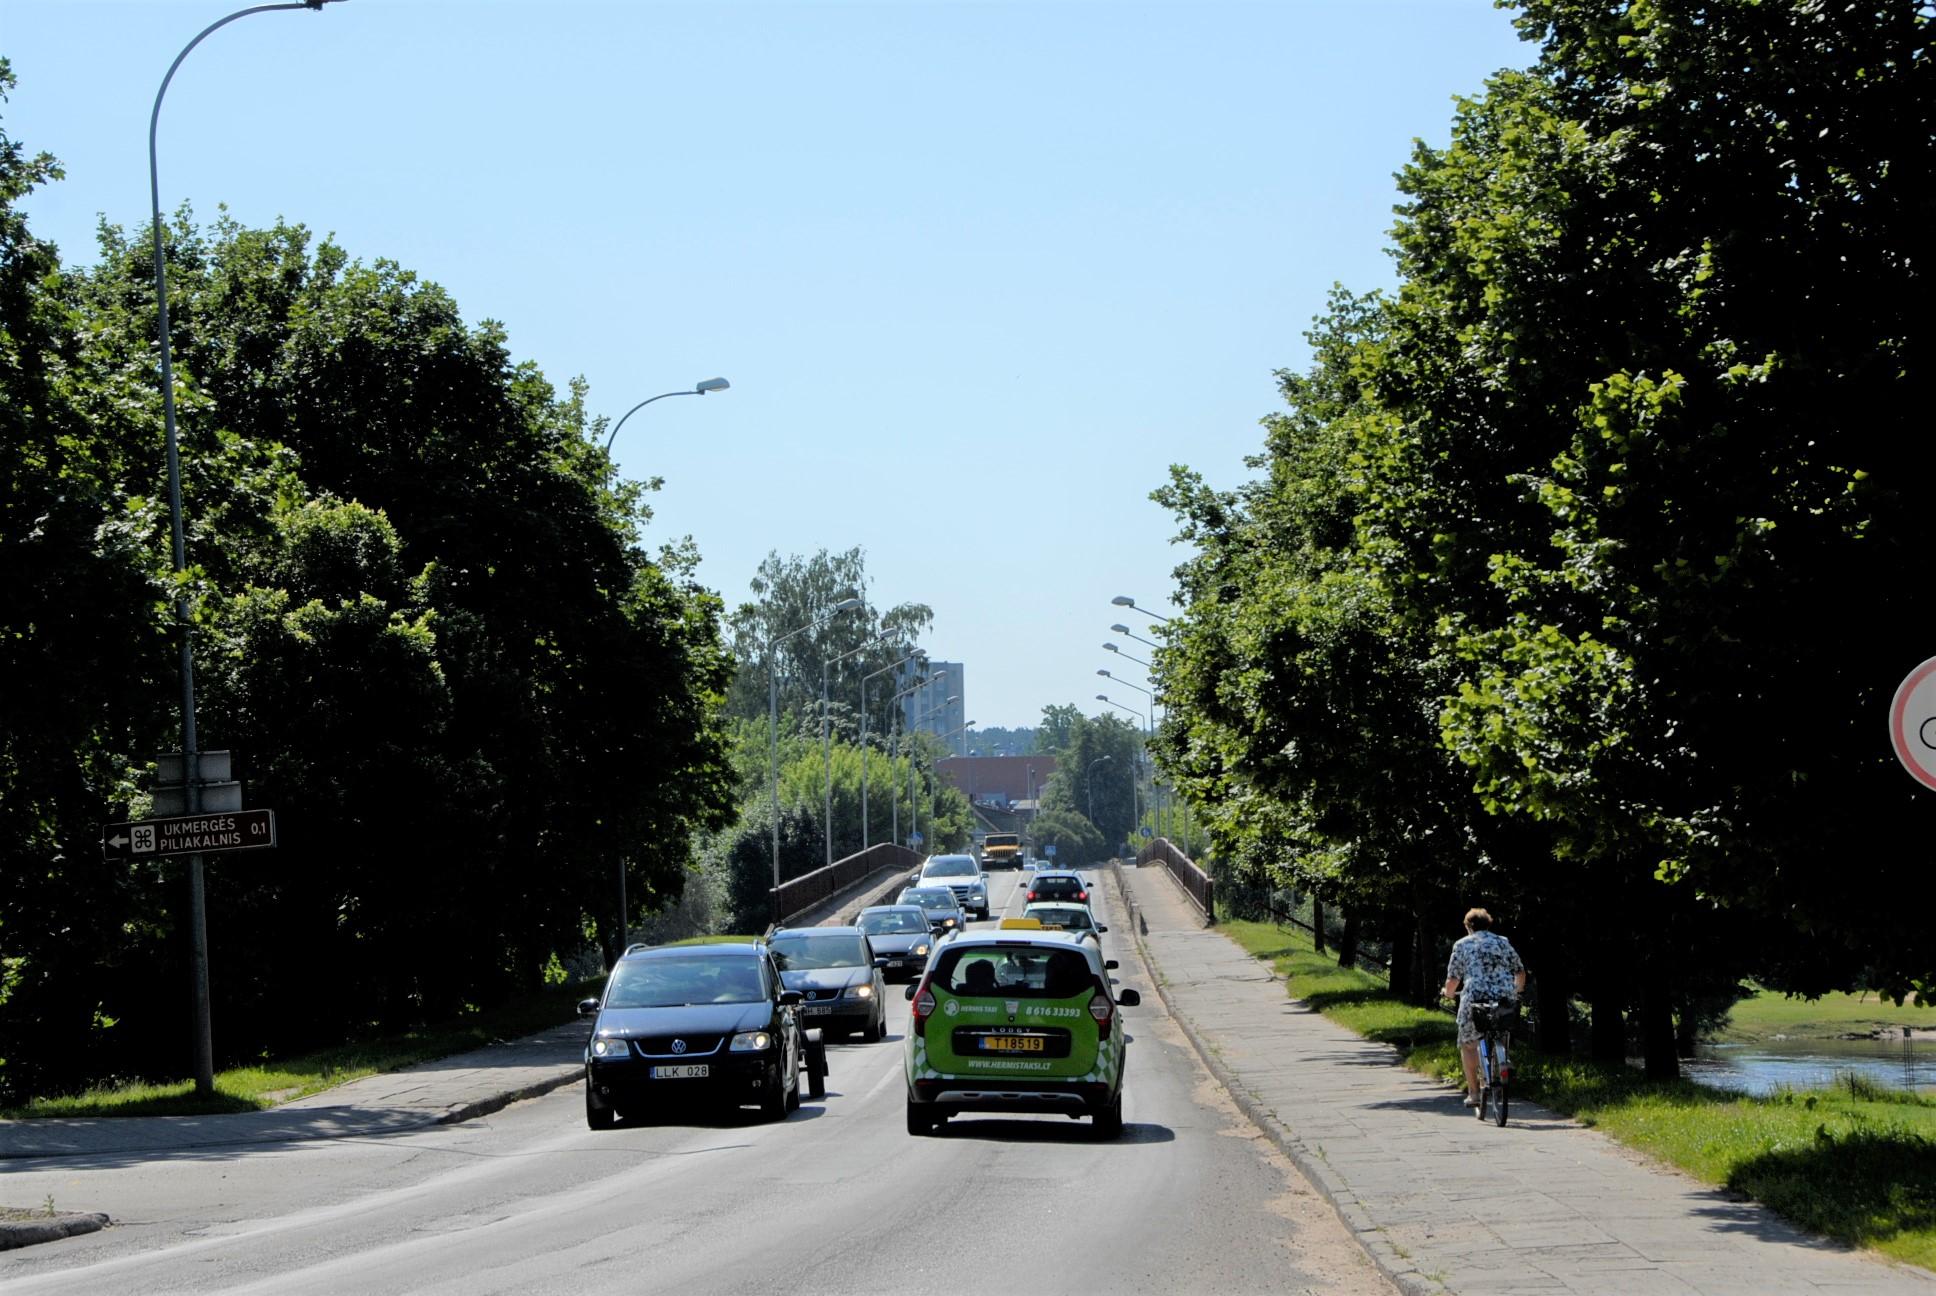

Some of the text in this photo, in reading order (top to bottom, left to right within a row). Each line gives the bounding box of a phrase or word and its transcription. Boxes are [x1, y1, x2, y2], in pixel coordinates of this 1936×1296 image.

[164, 816, 236, 836] UKMERGĖS
[160, 832, 241, 850] PILIAKALNIS
[995, 1038, 1040, 1050] T18519
[656, 1065, 707, 1078] LLK 028
